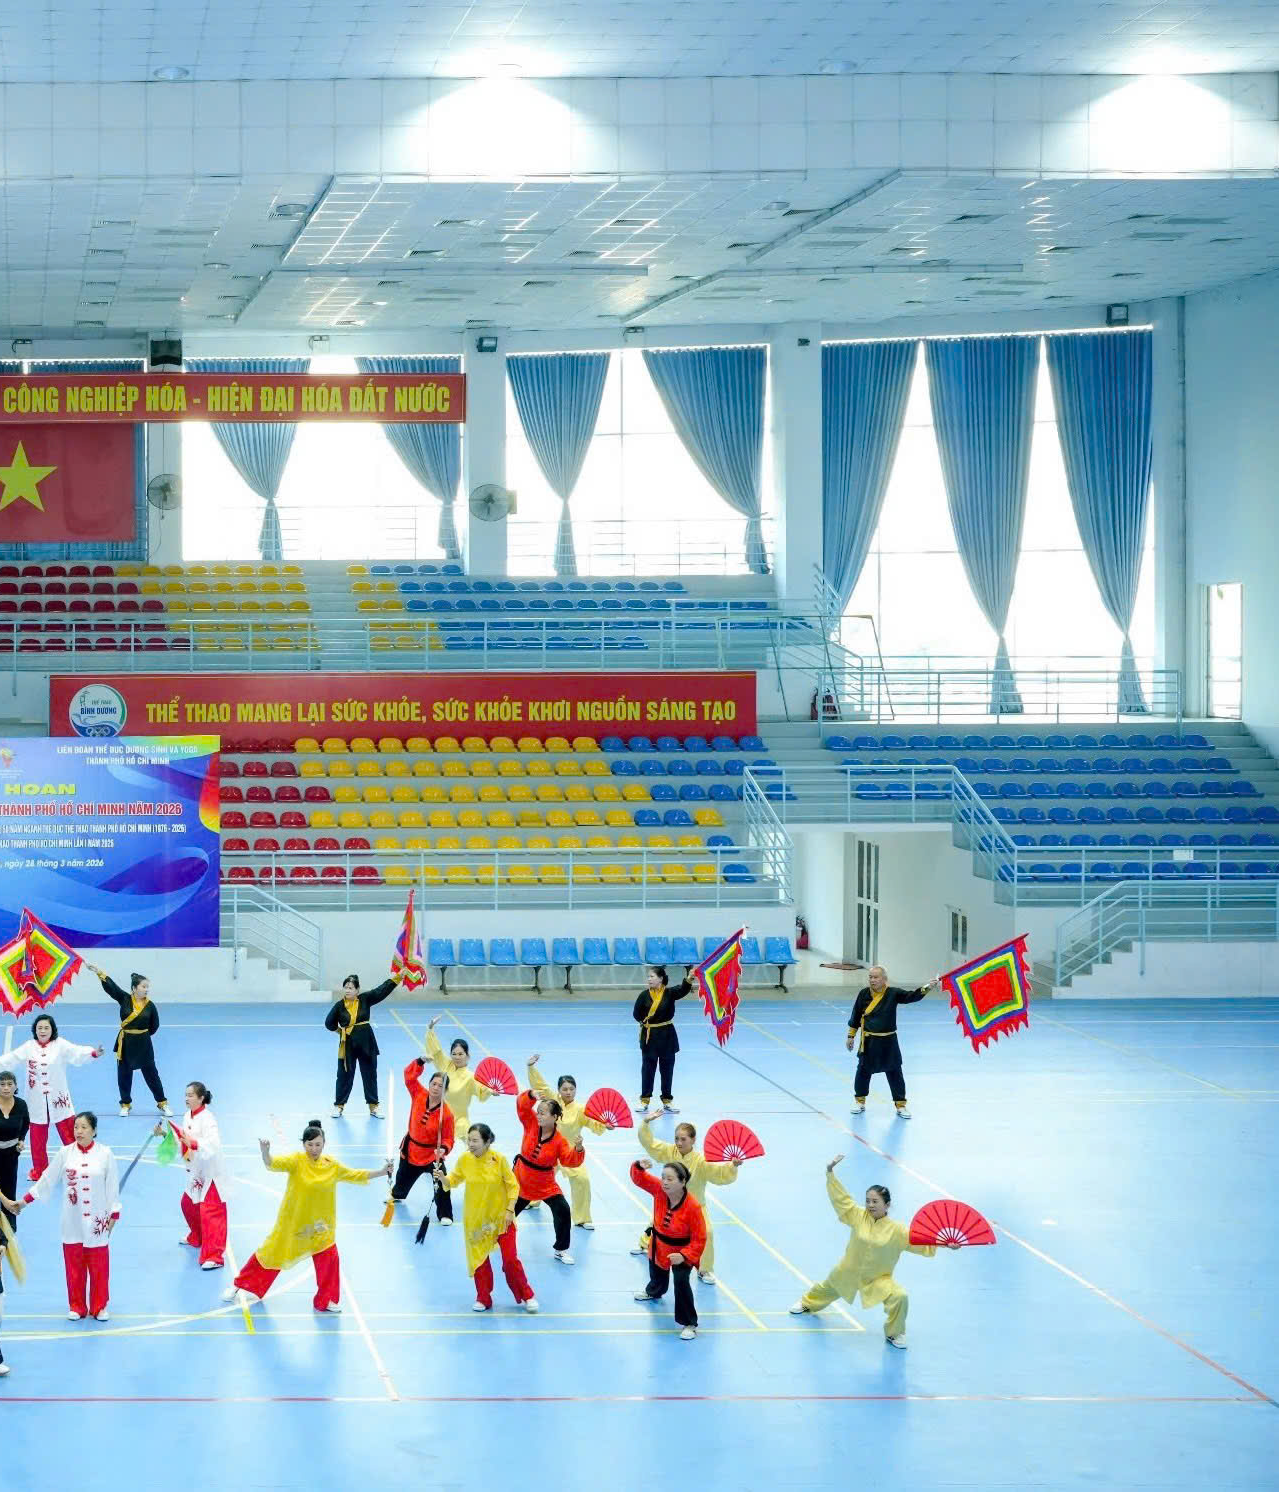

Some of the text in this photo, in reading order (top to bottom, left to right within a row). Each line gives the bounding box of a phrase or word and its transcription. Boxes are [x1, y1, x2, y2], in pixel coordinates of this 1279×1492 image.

[3, 382, 59, 413] CÔNG
[66, 381, 140, 416] NGHIỆP
[146, 381, 187, 412] HÓA
[207, 381, 253, 416] HIỆN
[260, 386, 294, 416] ĐẠI
[301, 381, 343, 412] HÓA
[349, 378, 389, 413] ĐẤT
[394, 382, 450, 413] NƯỚC
[80, 706, 95, 715] BÌNH
[146, 694, 736, 726] THỂ THAO MANG LẠI SỨC KHỎE, SỨC KHỎE KHƠI NGUỒN SÁNG TẠO
[5, 783, 76, 796] HOAN
[35, 800, 56, 816] PHỐ
[59, 800, 74, 816] HỒ
[77, 801, 95, 816] CHÍ
[97, 803, 125, 816] MINH
[128, 801, 153, 816] NĂM
[156, 803, 182, 816] 2026
[4, 859, 23, 870] ngày
[25, 859, 34, 867] 28
[37, 859, 58, 869] tháng
[60, 859, 65, 867] 3
[85, 859, 104, 867] 2026
